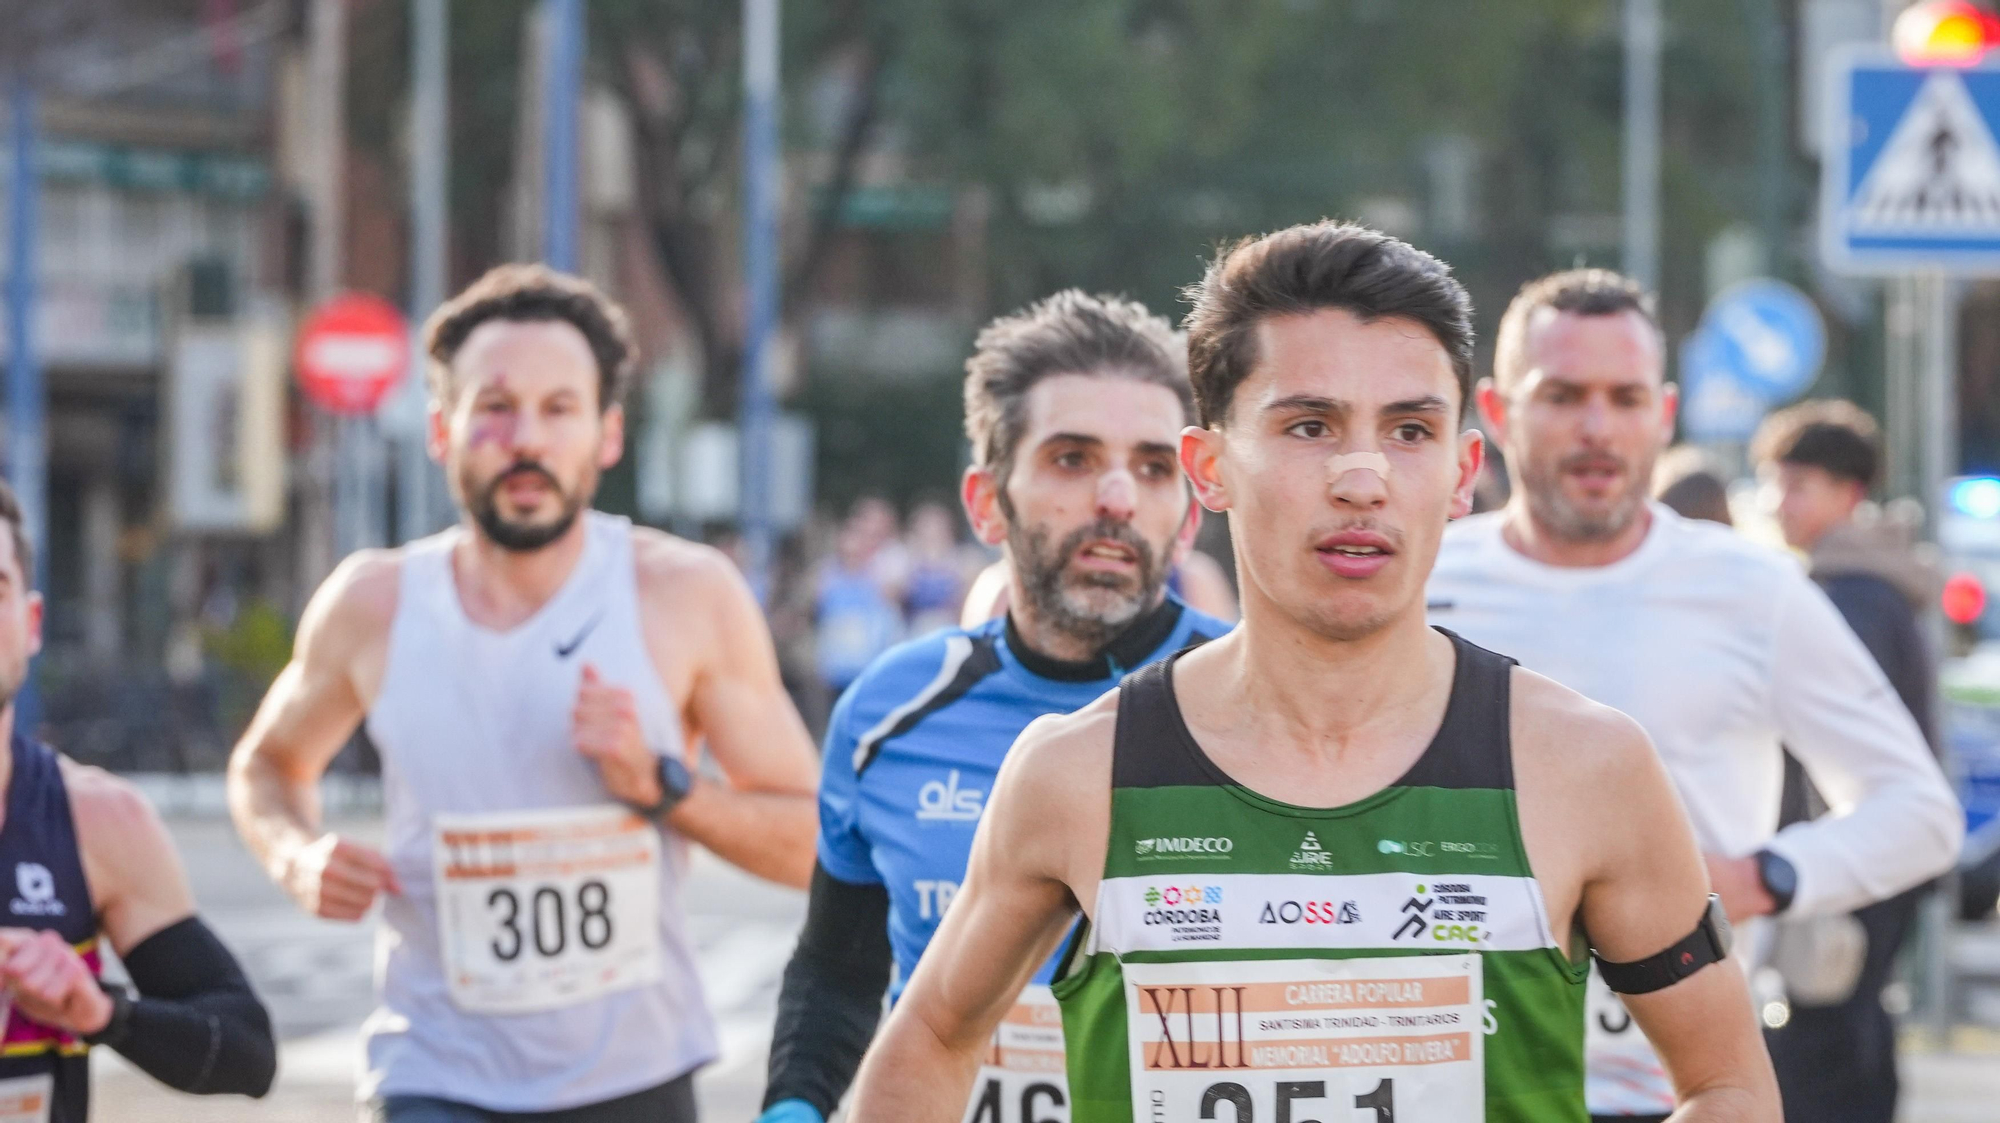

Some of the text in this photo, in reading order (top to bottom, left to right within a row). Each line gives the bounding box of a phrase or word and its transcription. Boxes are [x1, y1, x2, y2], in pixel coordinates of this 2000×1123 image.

[1156, 837, 1233, 853] IMDECO
[487, 881, 612, 962] 308
[1457, 910, 1488, 922] SPORT
[1432, 924, 1479, 942] CAC
[1285, 980, 1423, 1006] CARRERA POPULAR
[1143, 986, 1251, 1069] XLII
[1324, 1015, 1379, 1029] TRINIDAD
[1387, 1012, 1461, 1028] TRINITARIOS
[1251, 1044, 1331, 1068] MEMORIAL
